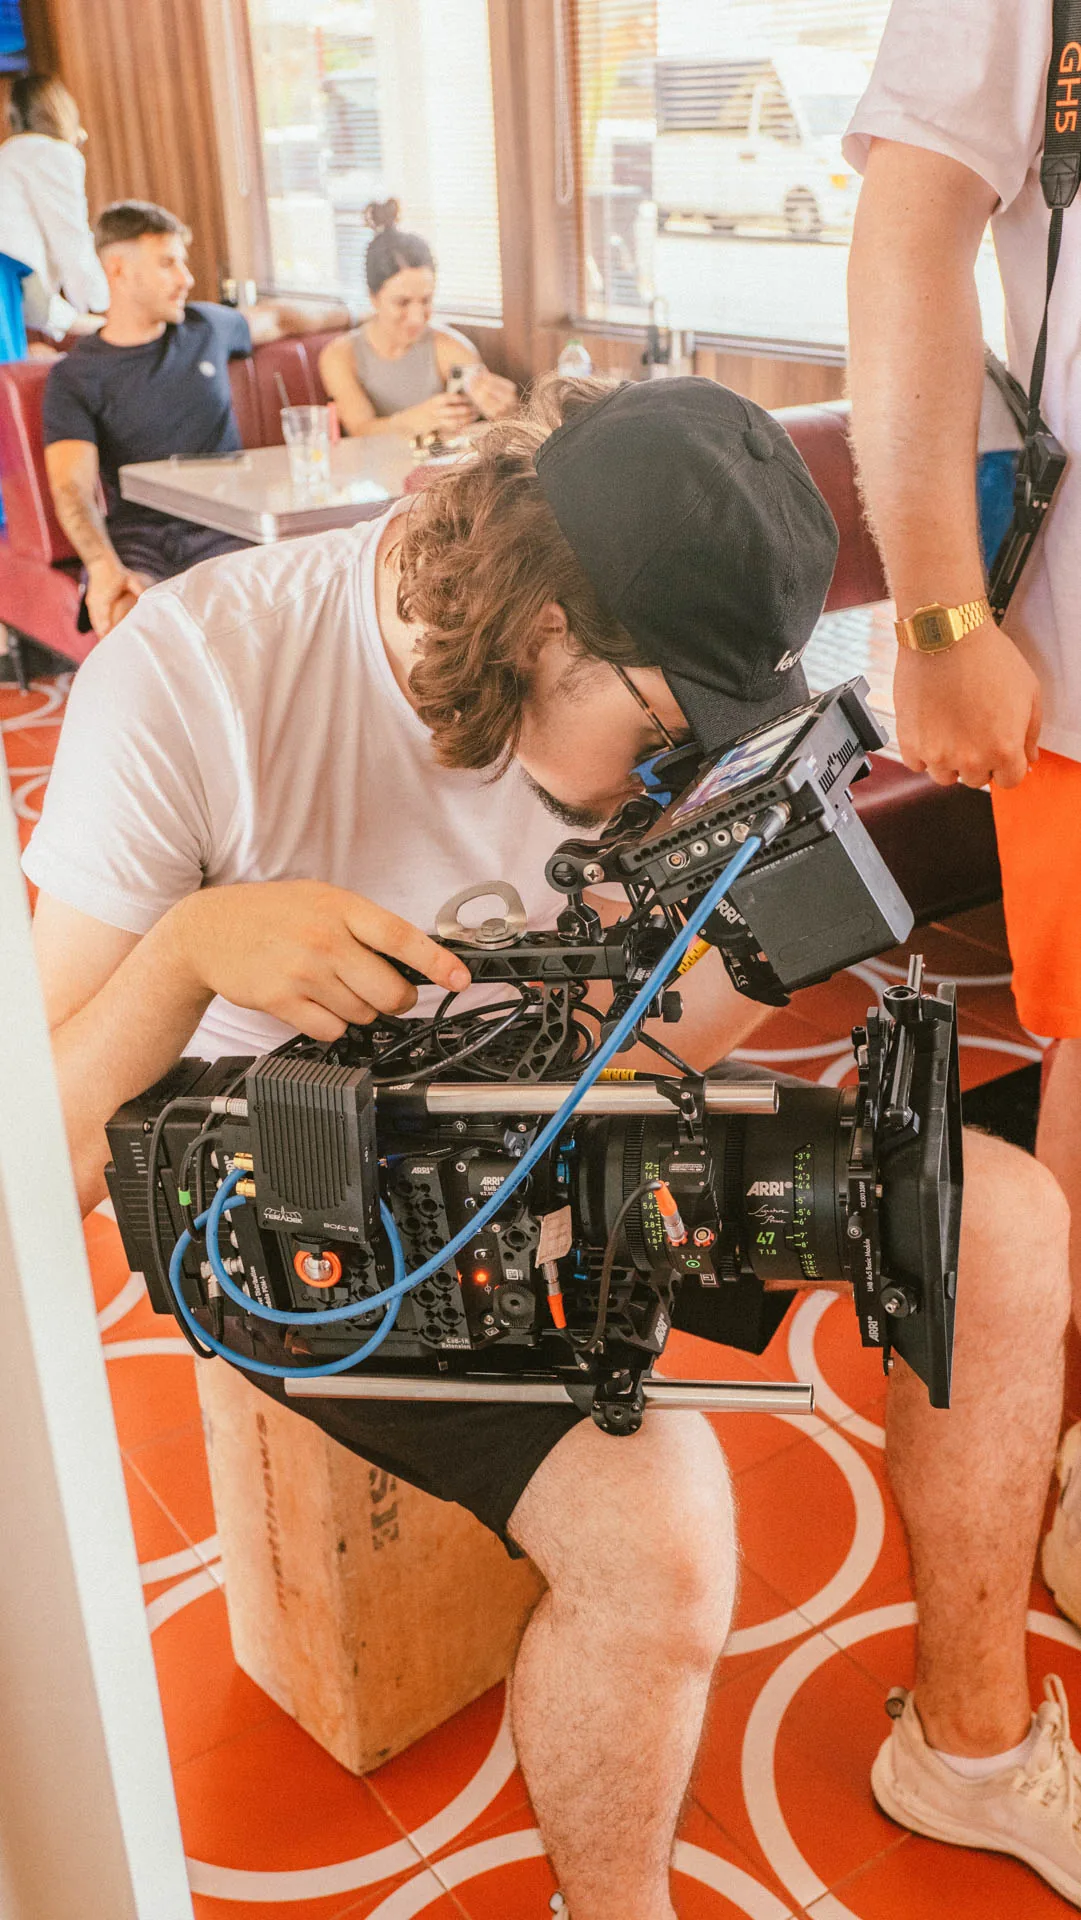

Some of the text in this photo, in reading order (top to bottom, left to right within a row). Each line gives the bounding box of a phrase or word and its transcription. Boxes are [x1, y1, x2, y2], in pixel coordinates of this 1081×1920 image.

[1055, 41, 1081, 133] GH5
[714, 899, 738, 925] RRI
[644, 1162, 653, 1170] 22
[480, 1176, 501, 1186] ARRI
[645, 1172, 653, 1180] 16
[746, 1181, 785, 1196] ARRI
[642, 1202, 654, 1210] 5.6
[263, 1212, 303, 1224] TERADEK
[756, 1231, 775, 1245] 47
[863, 1238, 871, 1257] Module
[653, 1316, 666, 1347] ARRI
[868, 1320, 880, 1342] ARRI
